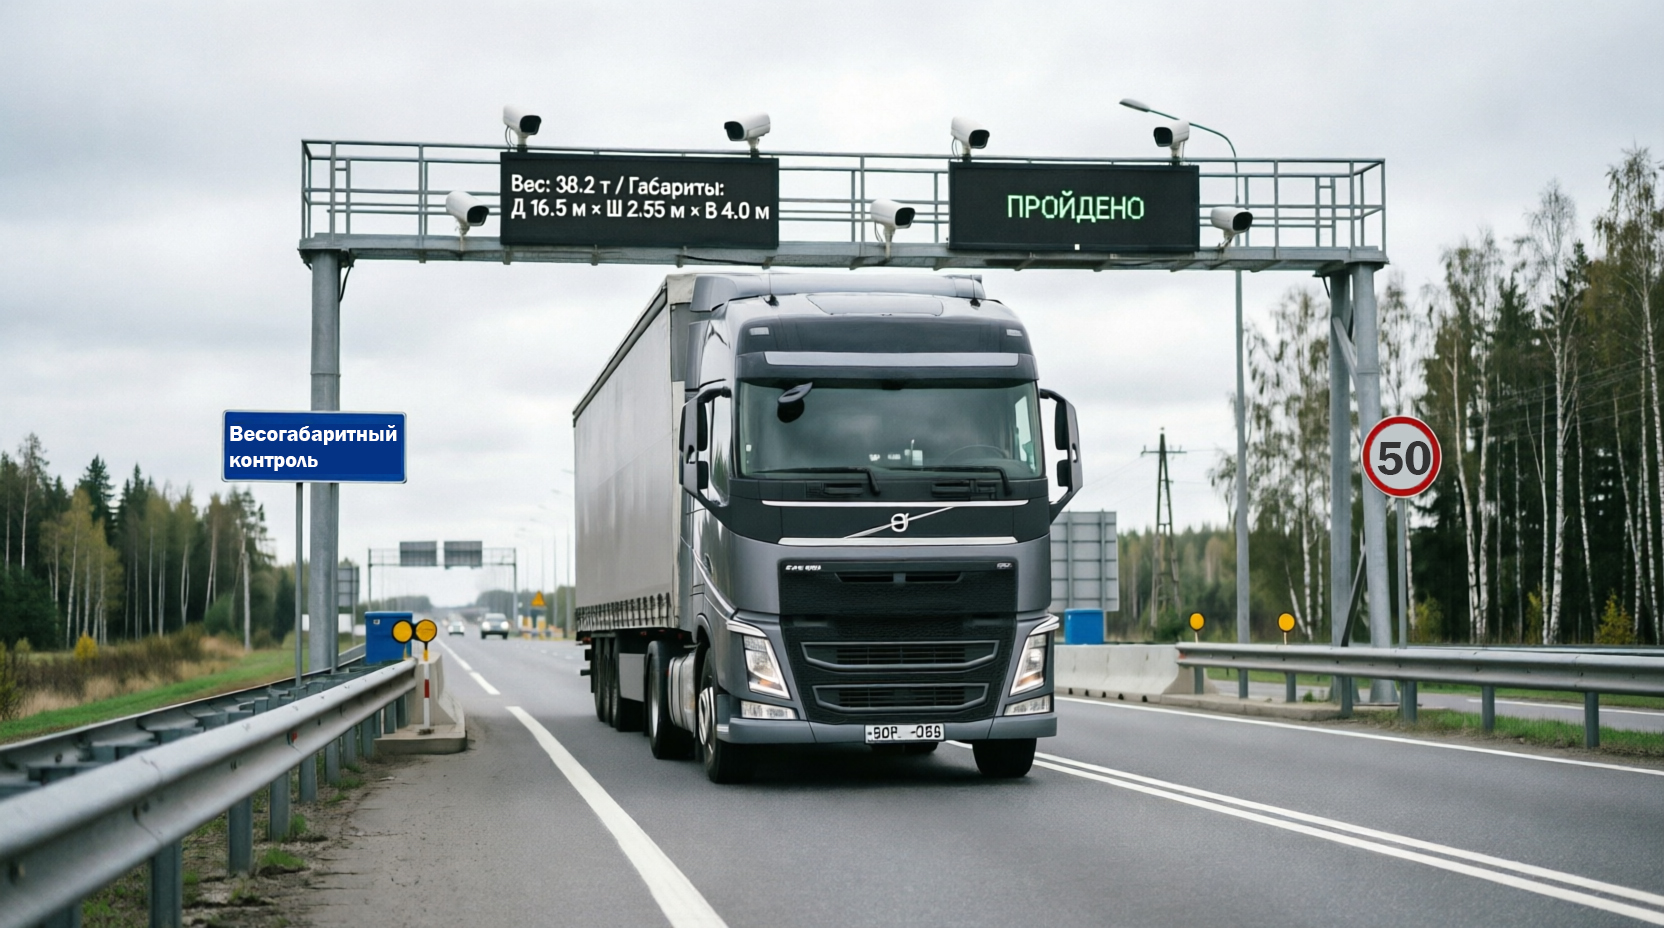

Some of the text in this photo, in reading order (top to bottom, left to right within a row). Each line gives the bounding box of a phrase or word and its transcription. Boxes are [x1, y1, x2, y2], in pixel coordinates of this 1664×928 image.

[511, 174, 724, 199] Вес: 38.2 т / Габариты:
[511, 198, 526, 219] Д
[531, 199, 567, 217] 16.5
[572, 203, 586, 217] м
[607, 201, 623, 218] Ш
[627, 200, 665, 218] 2.55
[670, 204, 685, 218] м
[705, 202, 717, 219] В
[721, 202, 750, 220] 4.0
[755, 206, 770, 220] м
[1007, 190, 1145, 223] ПРОЙДЕНО
[229, 425, 398, 446] Весогабаритный
[229, 455, 318, 472] контроль
[1378, 441, 1431, 476] 50
